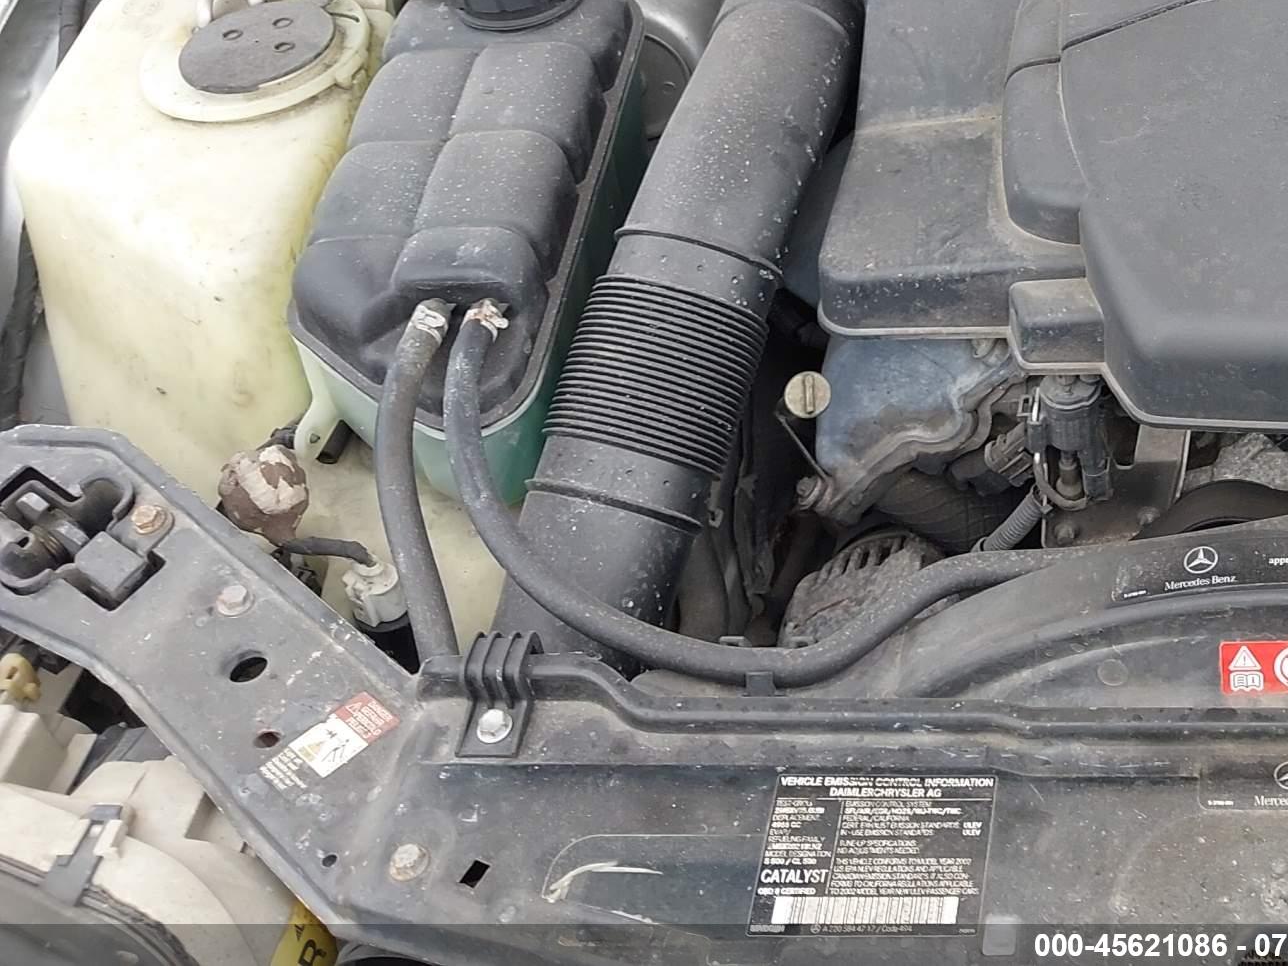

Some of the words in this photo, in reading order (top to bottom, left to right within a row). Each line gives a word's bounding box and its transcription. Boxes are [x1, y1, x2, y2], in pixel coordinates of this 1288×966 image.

[1164, 578, 1210, 591] Mercedes
[1212, 575, 1237, 585] Benz
[781, 777, 823, 787] VEHICLE
[824, 777, 873, 787] EMISSION
[925, 777, 993, 787] INFORMATION
[829, 788, 925, 797] DAIMLERCHRYSLER
[926, 788, 942, 797] AG
[761, 869, 829, 883] CATALYST
